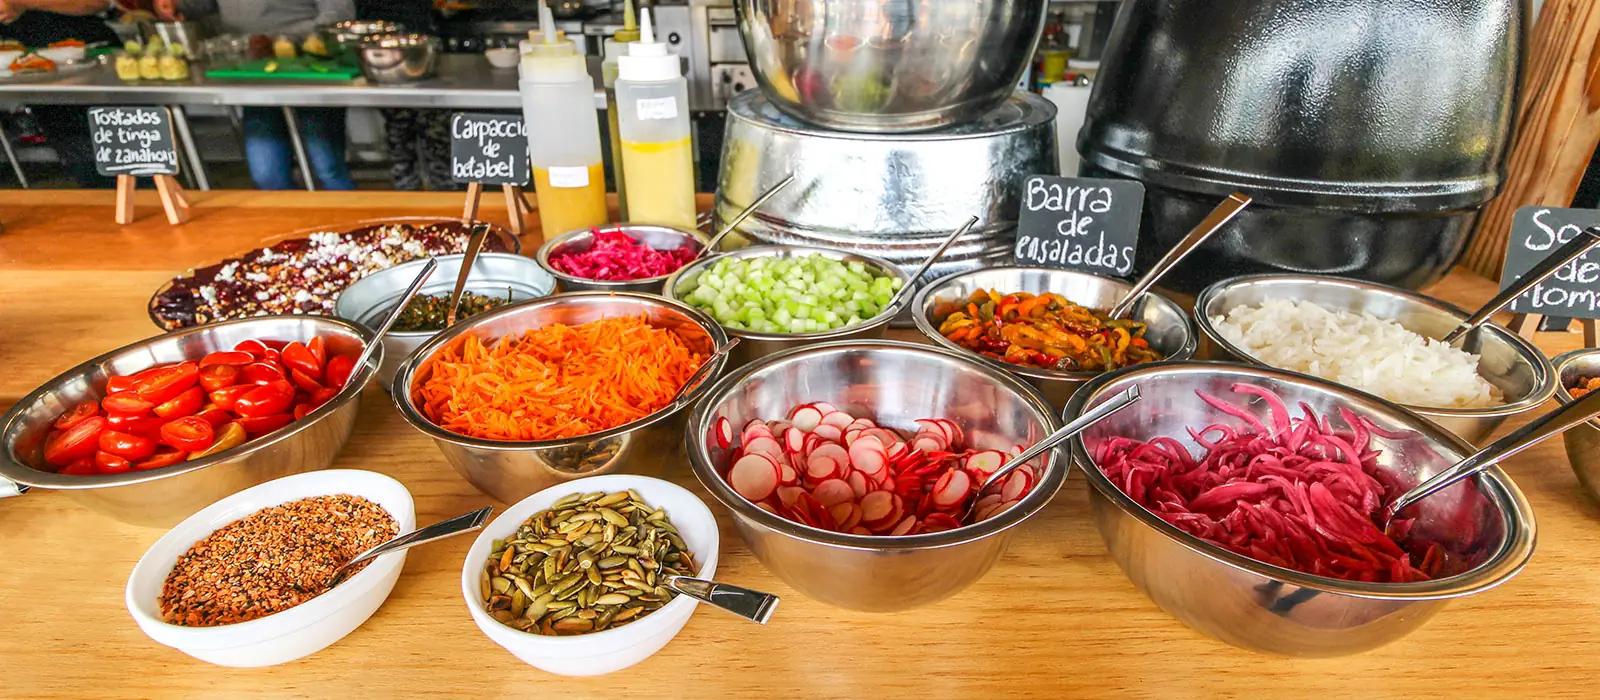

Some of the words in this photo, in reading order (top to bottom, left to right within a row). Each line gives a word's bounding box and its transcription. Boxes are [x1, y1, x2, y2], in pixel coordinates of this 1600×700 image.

[94, 126, 113, 144] de
[118, 126, 161, 148] tinga
[482, 138, 501, 158] de
[96, 146, 112, 162] de
[453, 154, 514, 178] betabel
[1027, 178, 1112, 213] Barra
[1057, 210, 1093, 237] de
[1015, 230, 1133, 273] ensaladas
[1554, 257, 1600, 283] de
